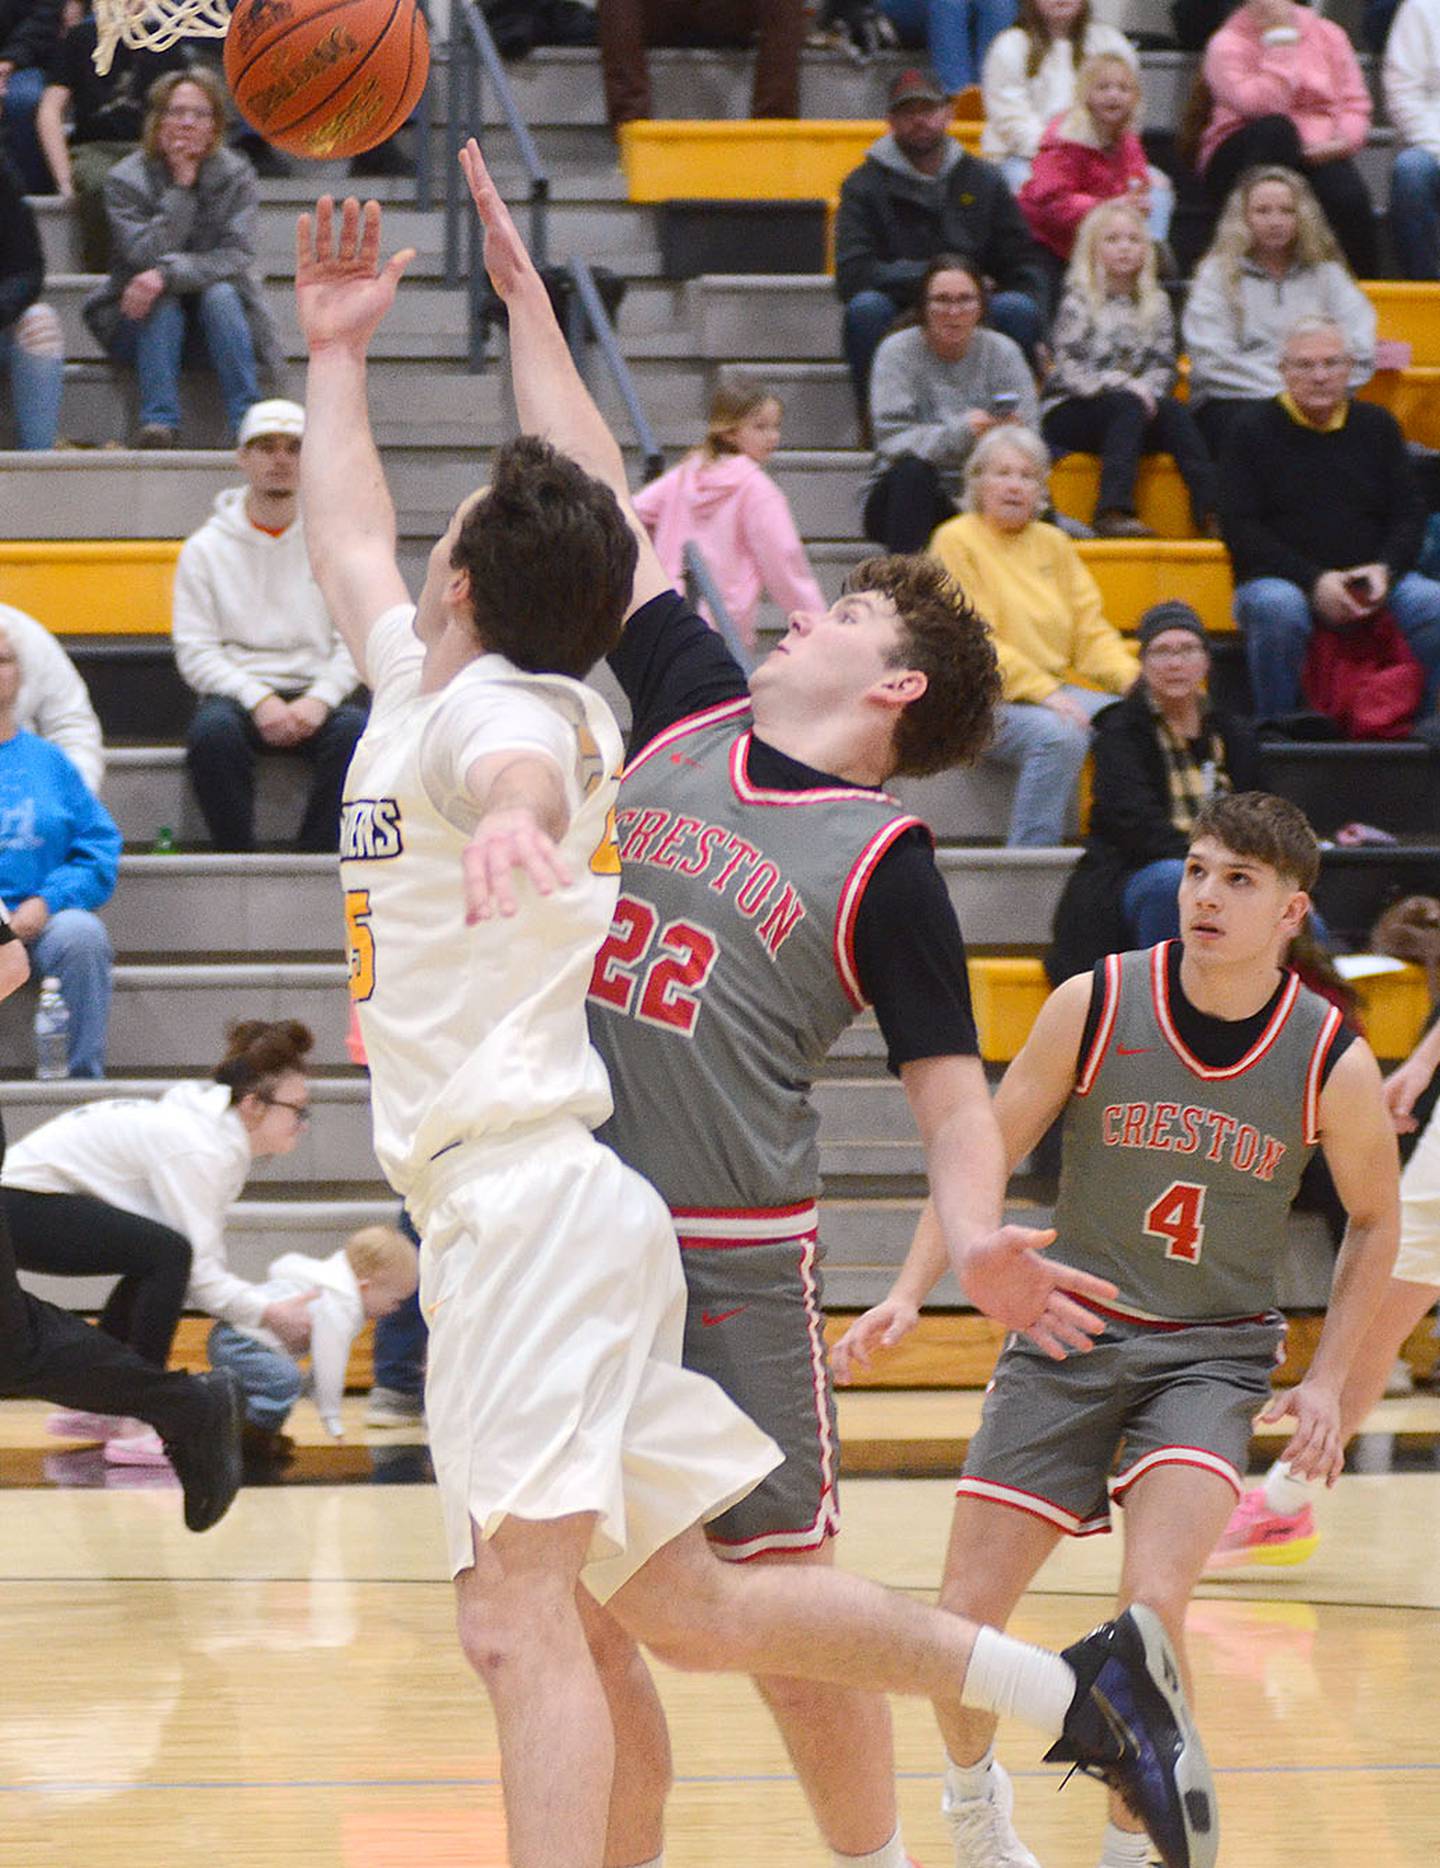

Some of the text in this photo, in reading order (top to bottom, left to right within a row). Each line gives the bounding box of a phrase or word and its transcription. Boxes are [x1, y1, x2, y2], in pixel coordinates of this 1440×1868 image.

[585, 893, 720, 1039] 22
[1102, 1100, 1287, 1182] CRESTON
[1142, 1180, 1208, 1265] 4
